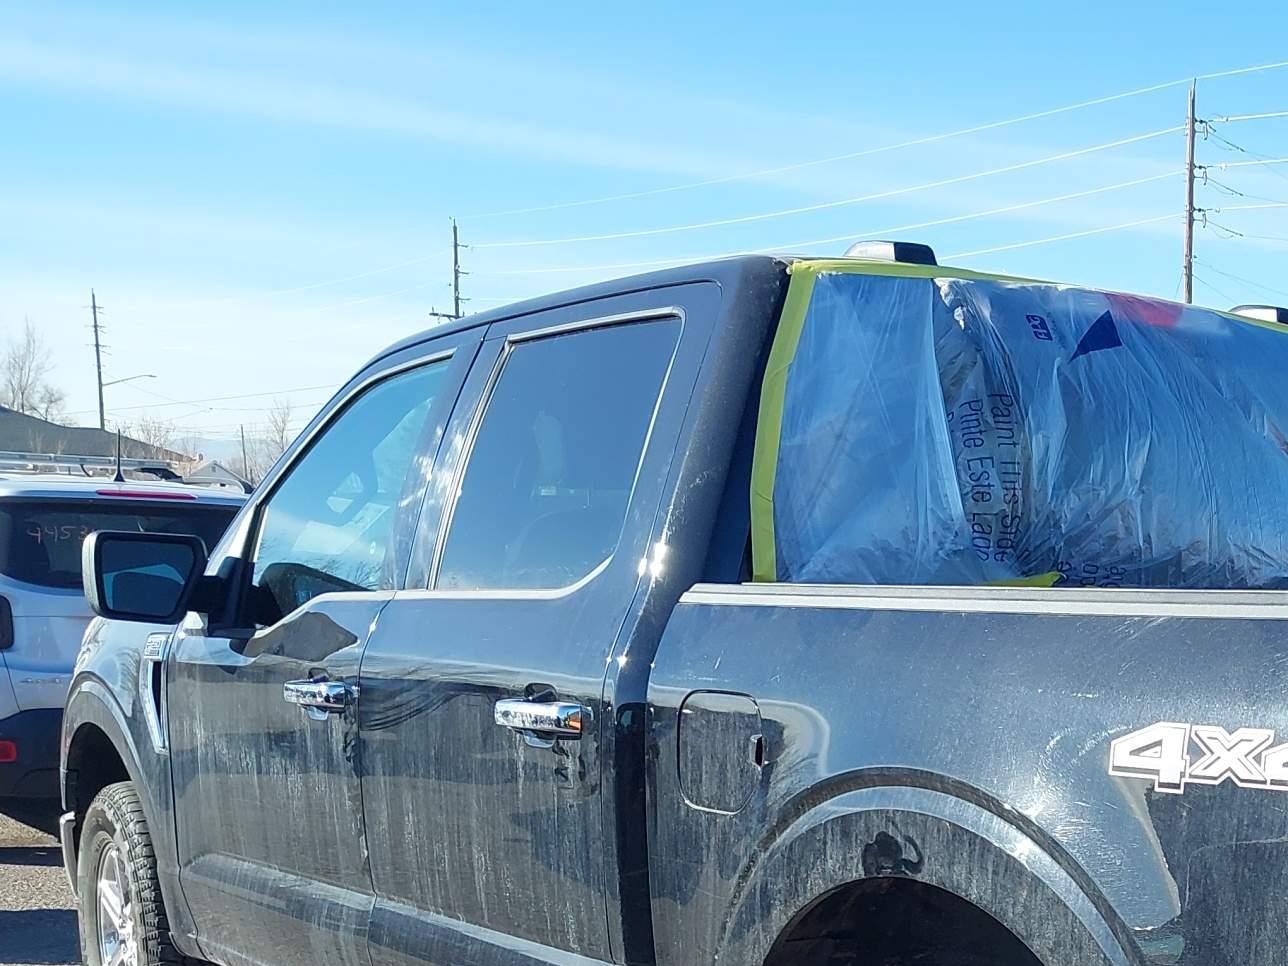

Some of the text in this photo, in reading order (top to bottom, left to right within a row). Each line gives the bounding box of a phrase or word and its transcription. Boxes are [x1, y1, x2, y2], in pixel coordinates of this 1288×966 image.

[959, 399, 988, 449] Pinte
[987, 393, 1021, 449] Paint
[966, 456, 996, 504] Este
